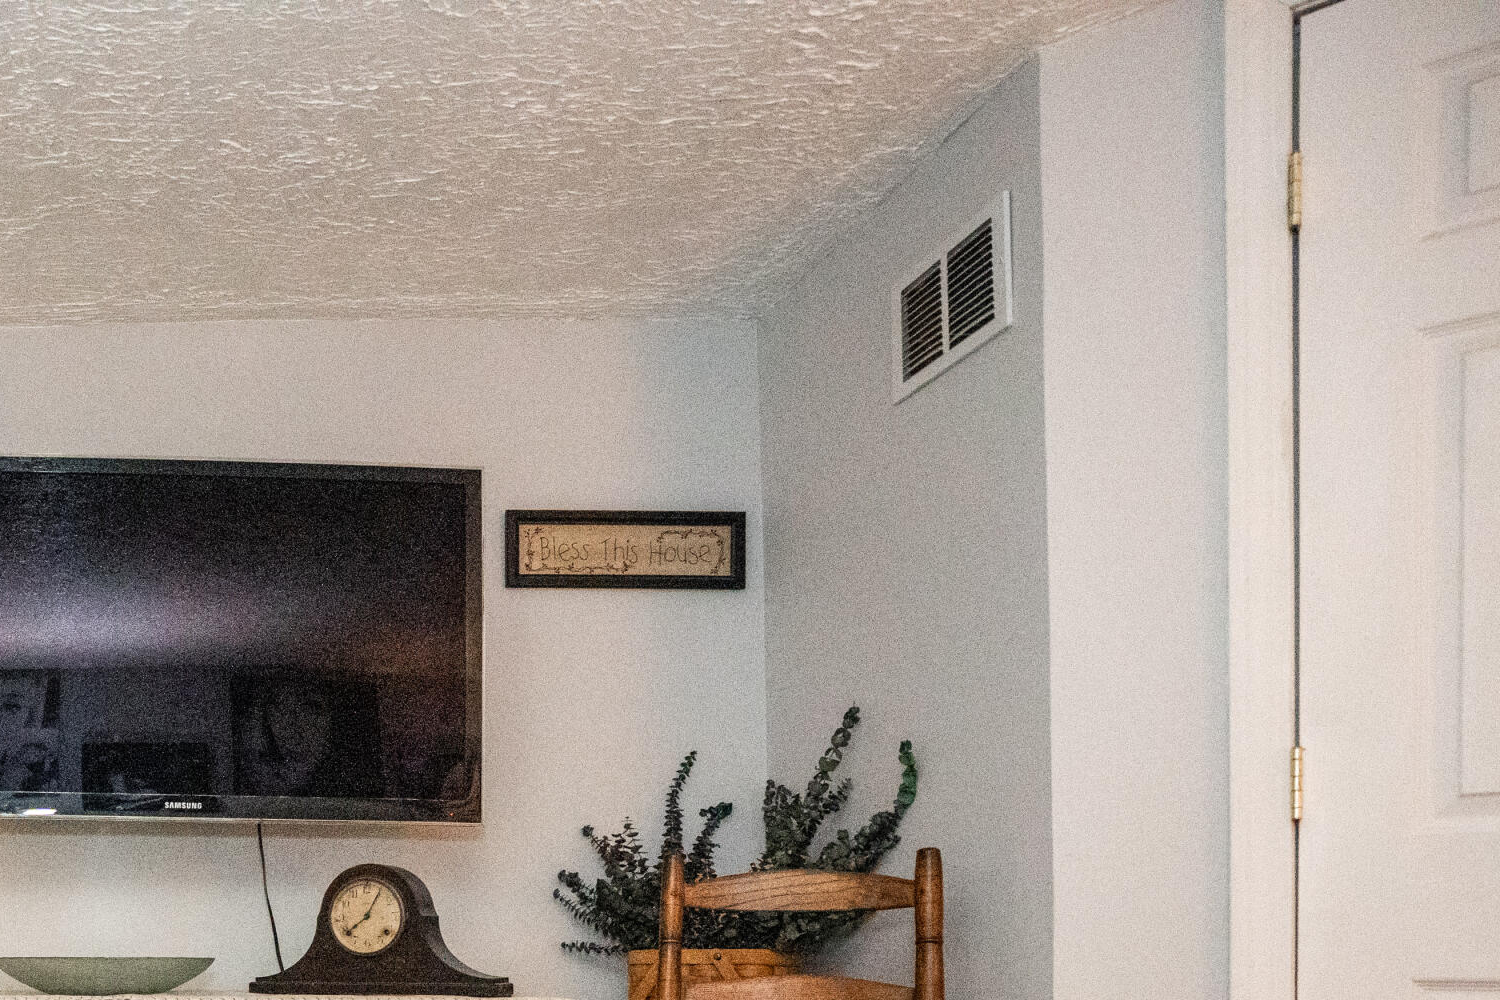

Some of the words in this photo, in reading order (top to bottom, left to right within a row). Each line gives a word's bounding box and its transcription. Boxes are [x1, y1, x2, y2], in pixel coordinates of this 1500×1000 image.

[540, 536, 590, 562] Bless
[601, 536, 639, 564] This
[649, 540, 712, 567] House
[164, 801, 203, 810] SAMSUNG
